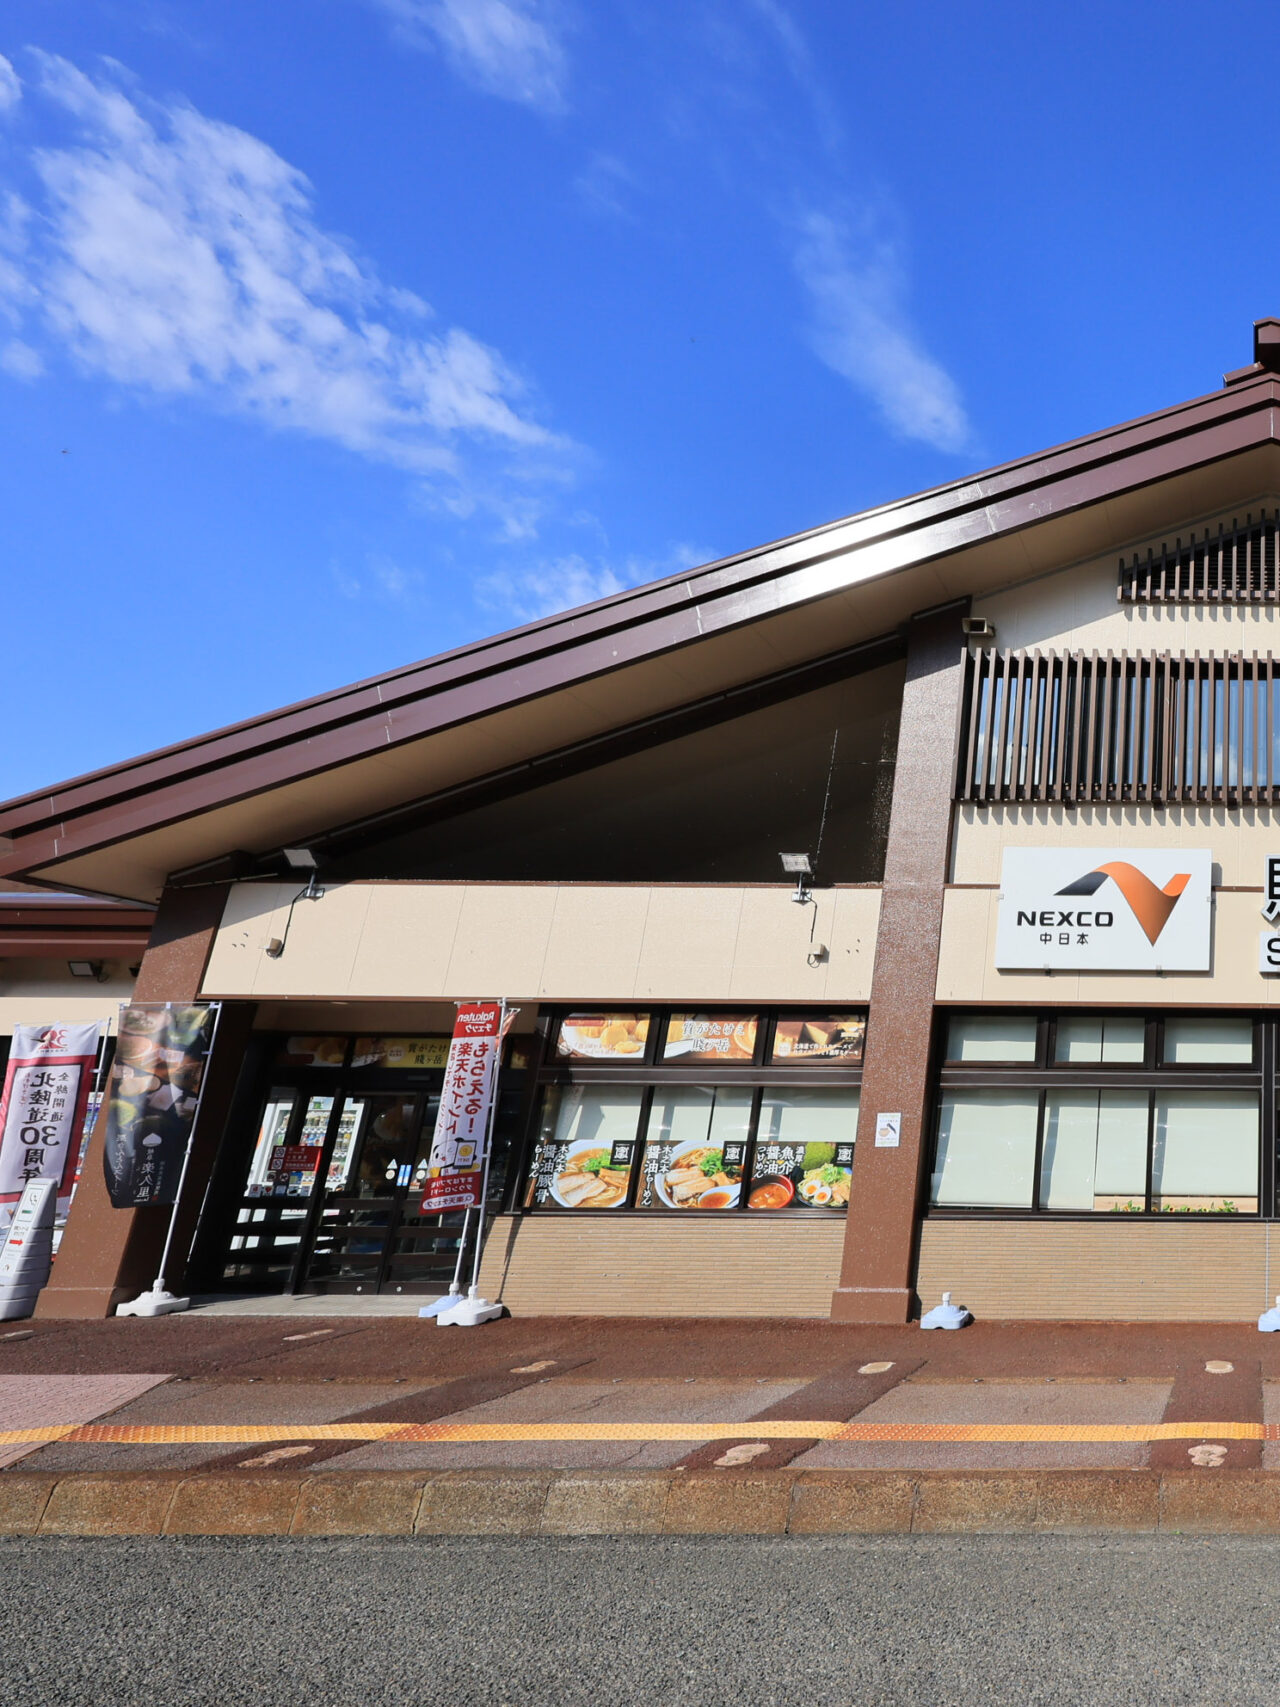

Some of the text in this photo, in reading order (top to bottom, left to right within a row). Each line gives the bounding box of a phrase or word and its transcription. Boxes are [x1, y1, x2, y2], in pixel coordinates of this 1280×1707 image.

[1017, 911, 1114, 927] NEXCO
[1039, 932, 1089, 945] 中日本
